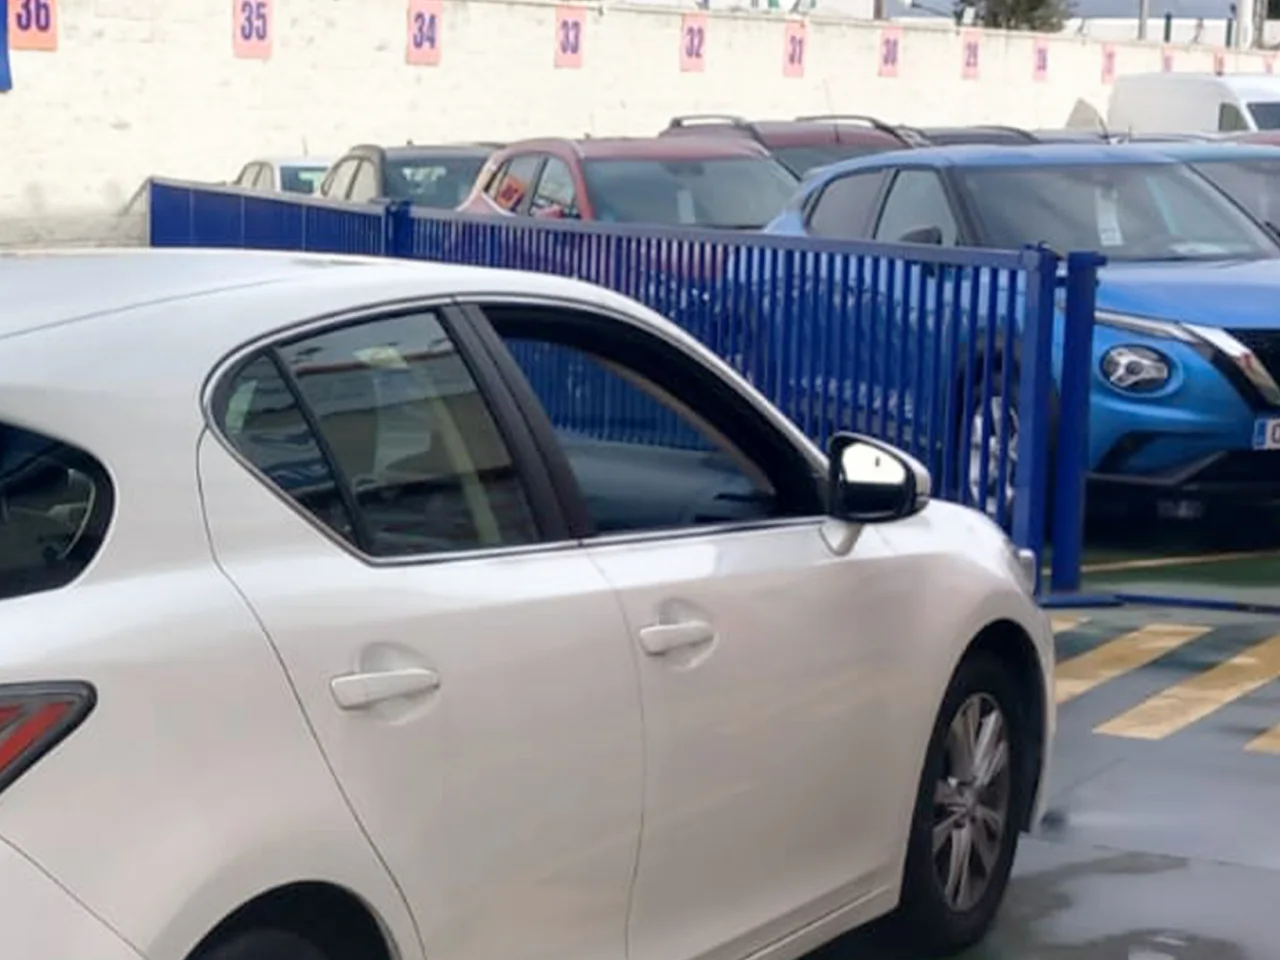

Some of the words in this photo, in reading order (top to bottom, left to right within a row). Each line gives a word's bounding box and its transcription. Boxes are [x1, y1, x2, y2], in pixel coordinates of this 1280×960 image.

[15, 0, 51, 32] 36
[240, 0, 268, 42] 35
[413, 12, 437, 50] 34
[561, 20, 581, 54] 33
[686, 26, 705, 59] 32
[789, 34, 804, 66] 31
